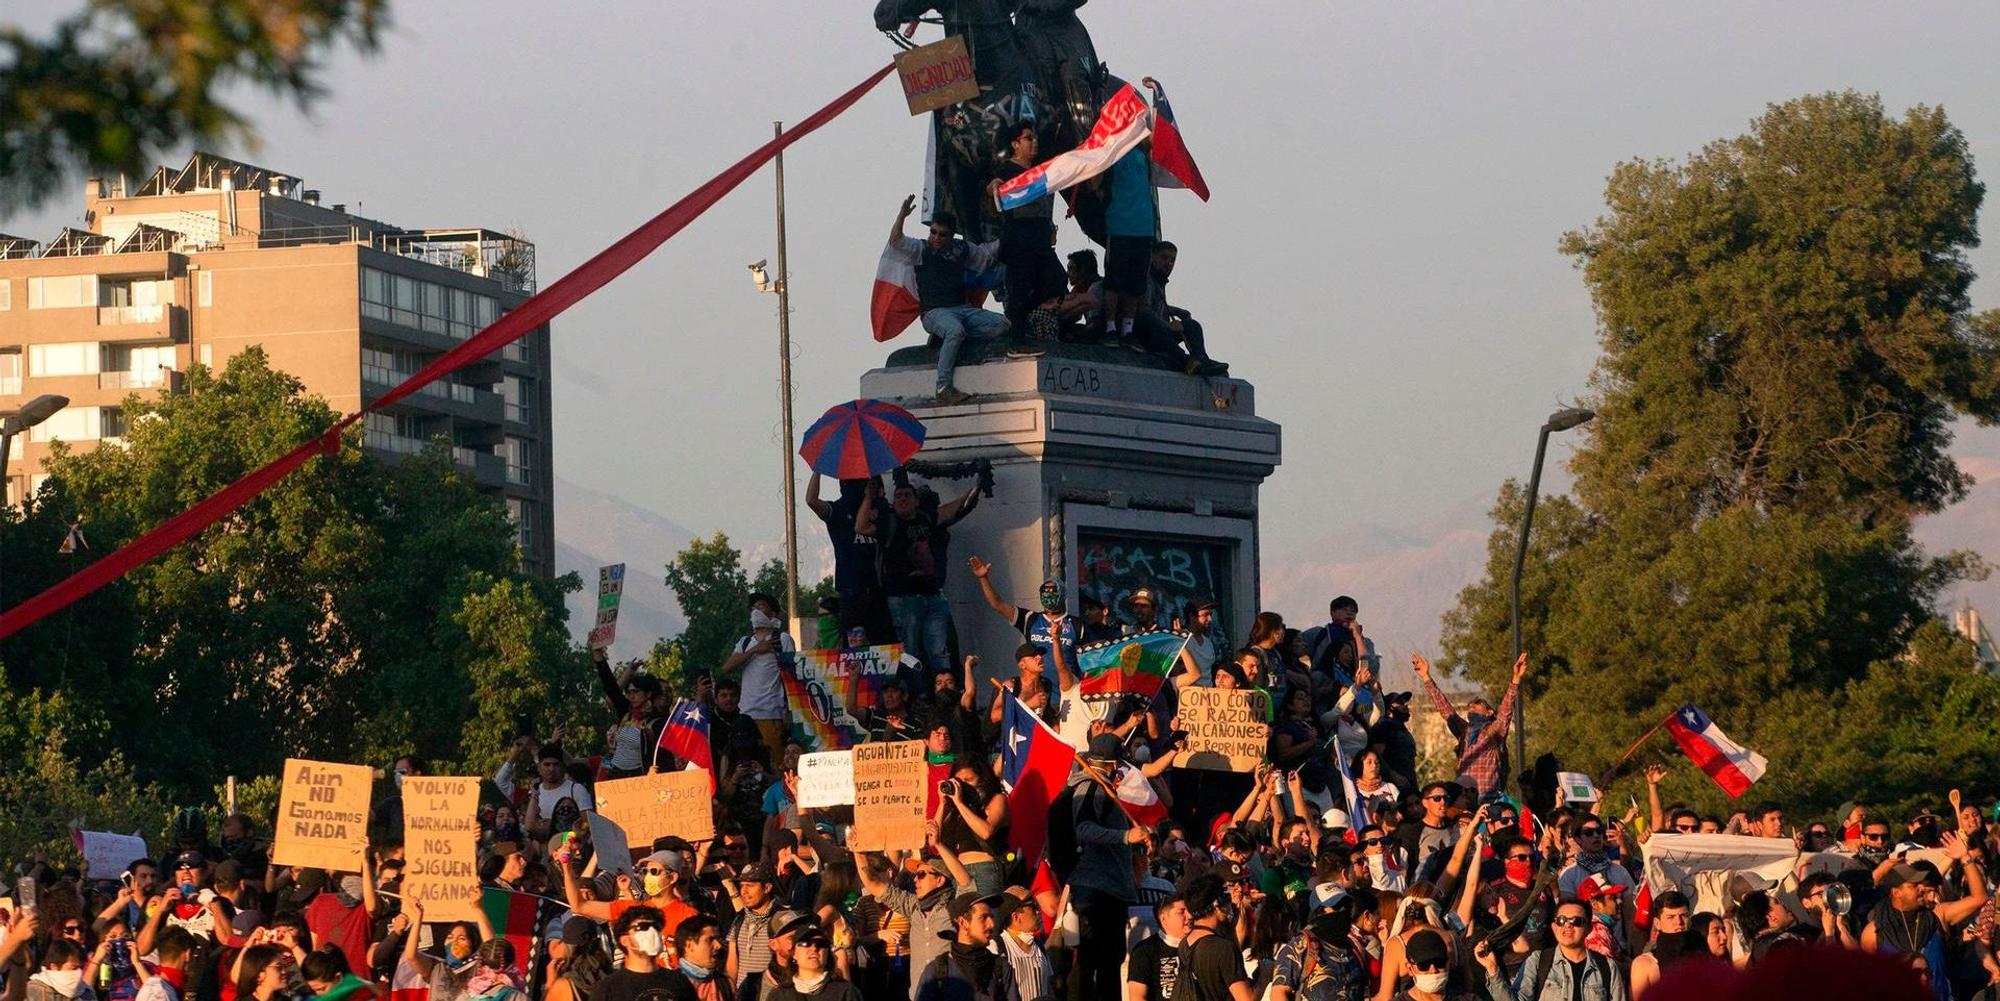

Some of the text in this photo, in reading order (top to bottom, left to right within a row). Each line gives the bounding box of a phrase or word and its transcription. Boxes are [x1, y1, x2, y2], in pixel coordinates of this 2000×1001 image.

[839, 650, 885, 662] PARTID
[1180, 688, 1221, 708] COMO
[1207, 707, 1267, 724] RAZONA
[857, 743, 908, 762] AGUANTE
[295, 765, 343, 788] Aún
[308, 785, 336, 804] NO
[857, 796, 867, 807] SE
[288, 799, 364, 825] Ganamos
[429, 798, 450, 812] LA
[293, 820, 348, 840] NADA
[423, 838, 453, 856] NOS
[410, 856, 472, 878] SIGUEN
